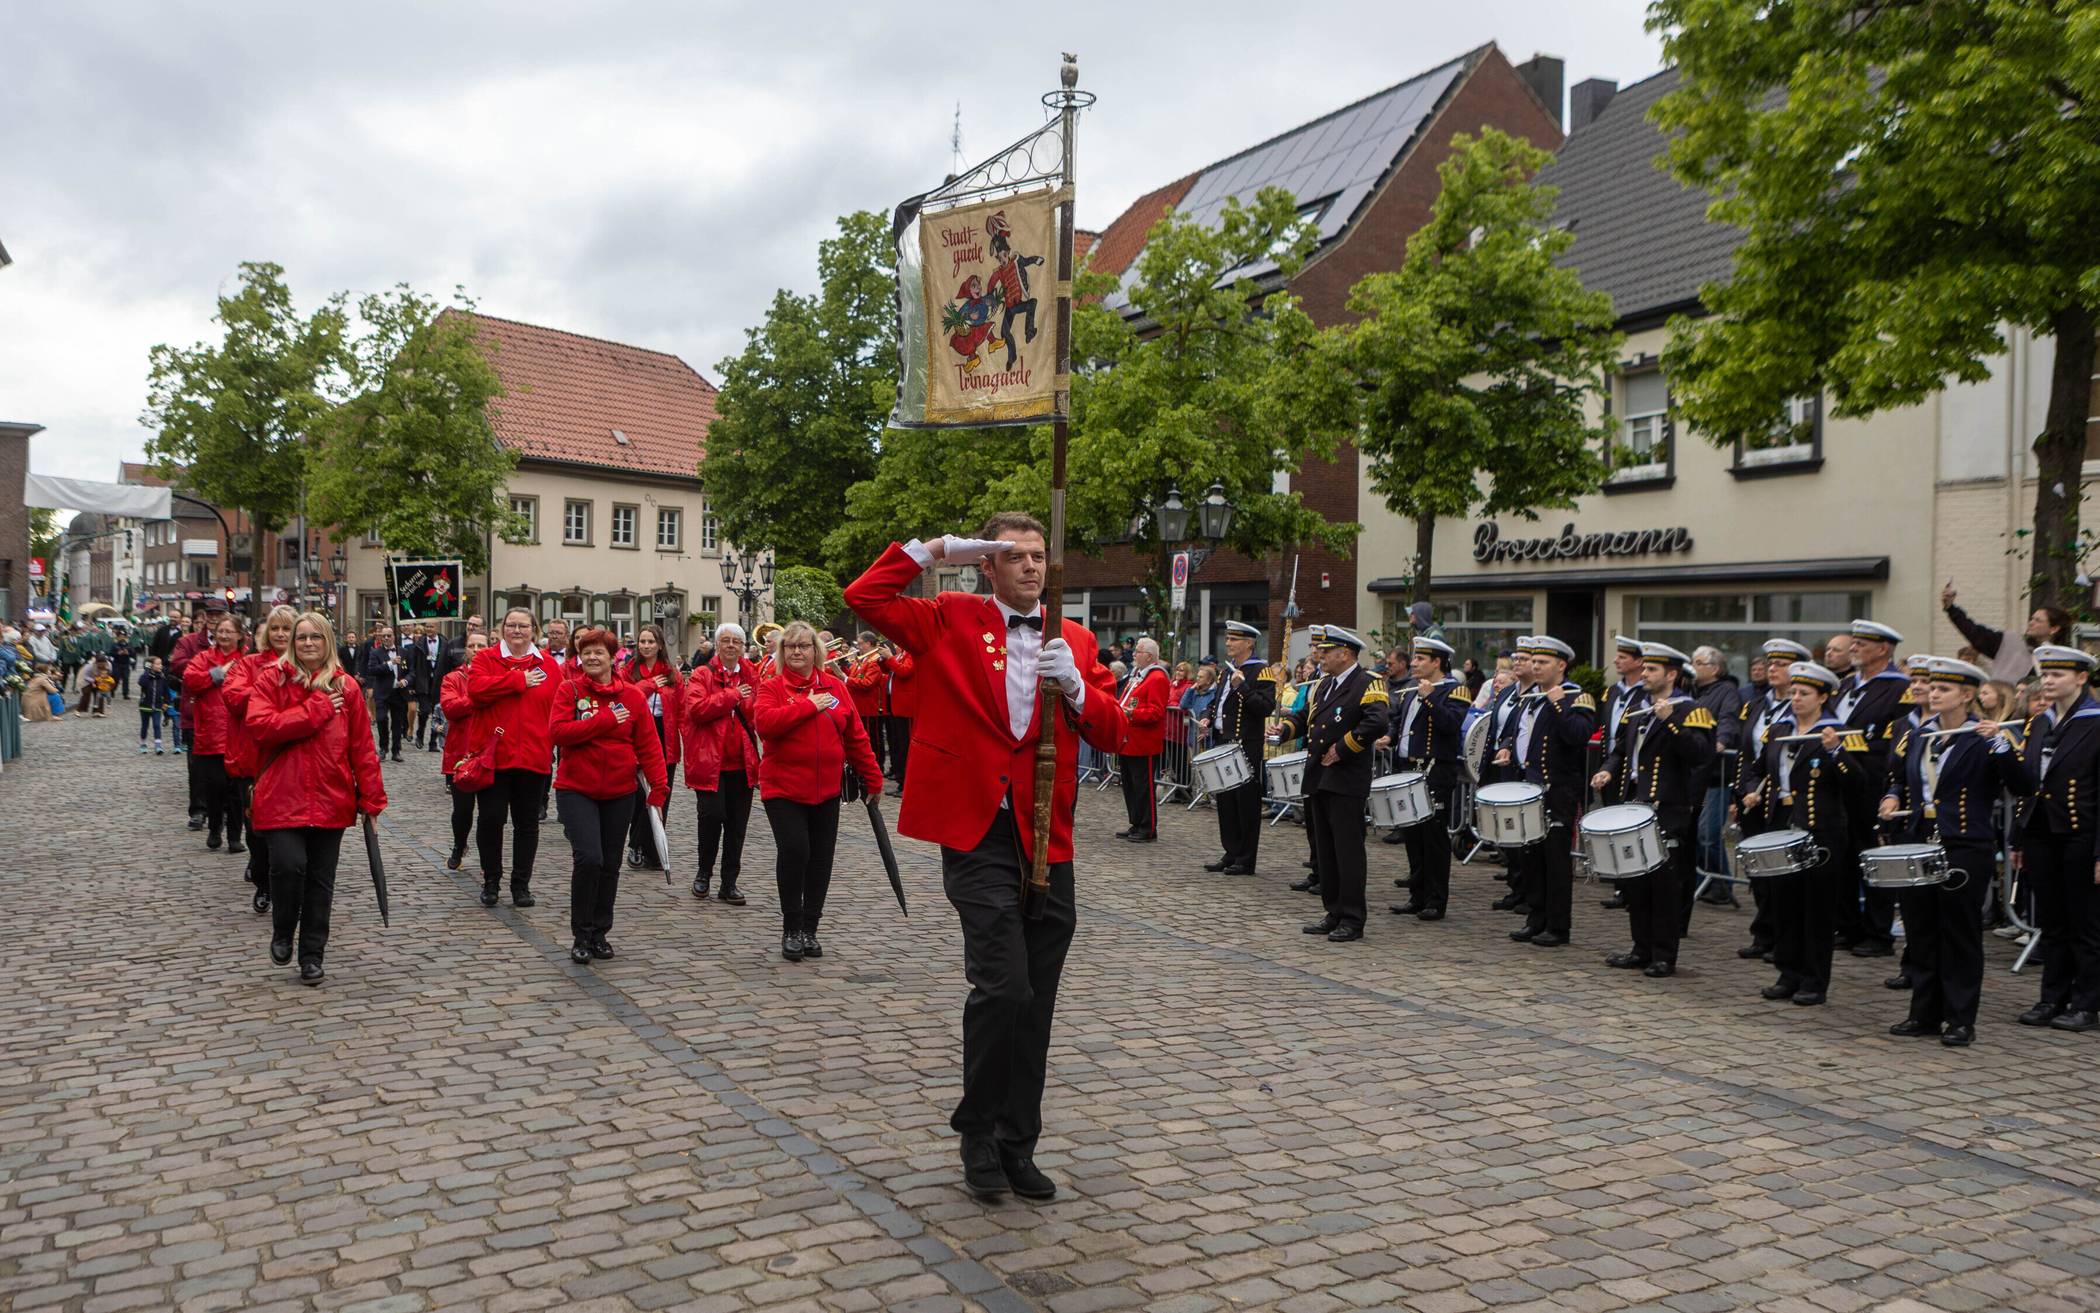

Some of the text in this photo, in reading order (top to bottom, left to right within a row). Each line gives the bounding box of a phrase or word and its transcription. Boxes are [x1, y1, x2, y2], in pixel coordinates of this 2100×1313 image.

[953, 243, 984, 279] garde
[954, 356, 1032, 395] Trinagarde
[1473, 521, 1694, 563] Broeckmann
